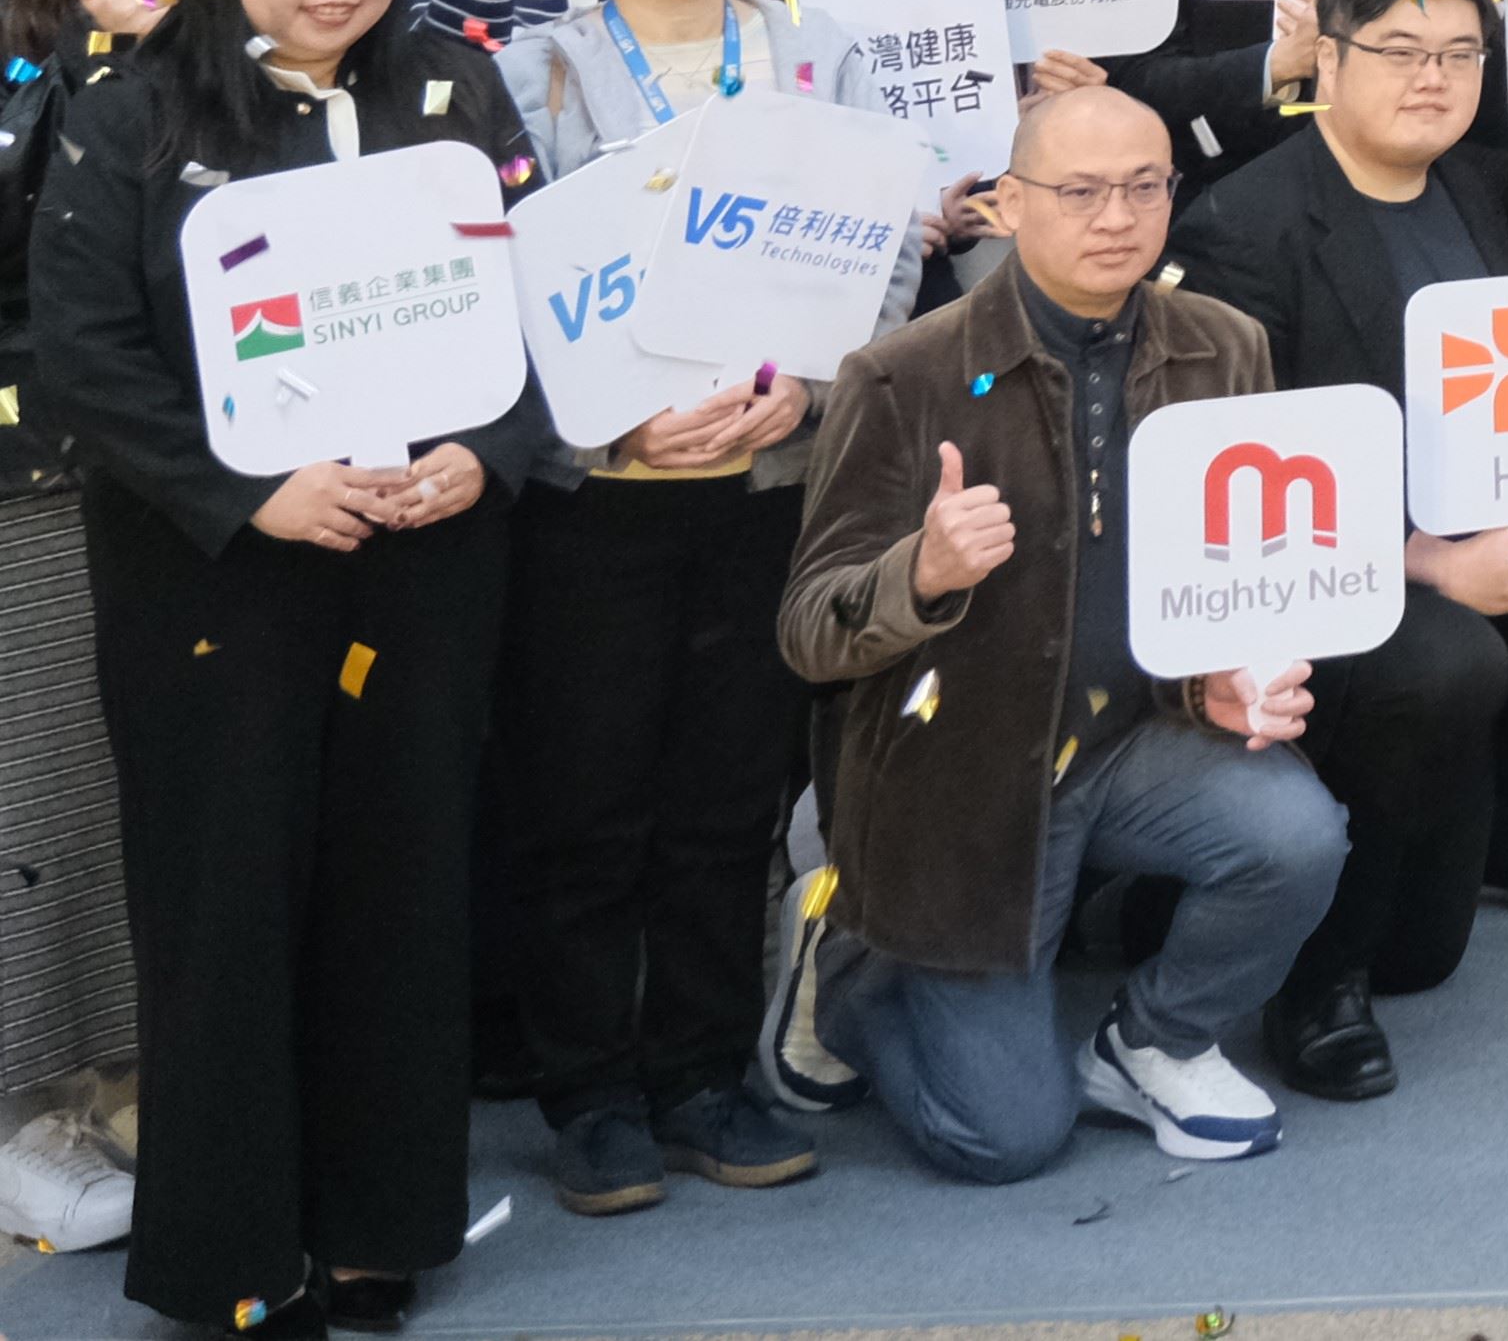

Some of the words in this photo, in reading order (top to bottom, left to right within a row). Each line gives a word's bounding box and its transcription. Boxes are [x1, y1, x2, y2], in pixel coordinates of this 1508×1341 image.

[683, 186, 768, 250] V5
[767, 201, 896, 253] 倍利科技
[309, 255, 477, 312] 信義企業集團
[759, 240, 880, 277] Technologies
[312, 313, 383, 345] SINYI
[391, 291, 482, 326] GROUP
[1159, 577, 1297, 623] Mighty
[1307, 561, 1380, 603] Net
